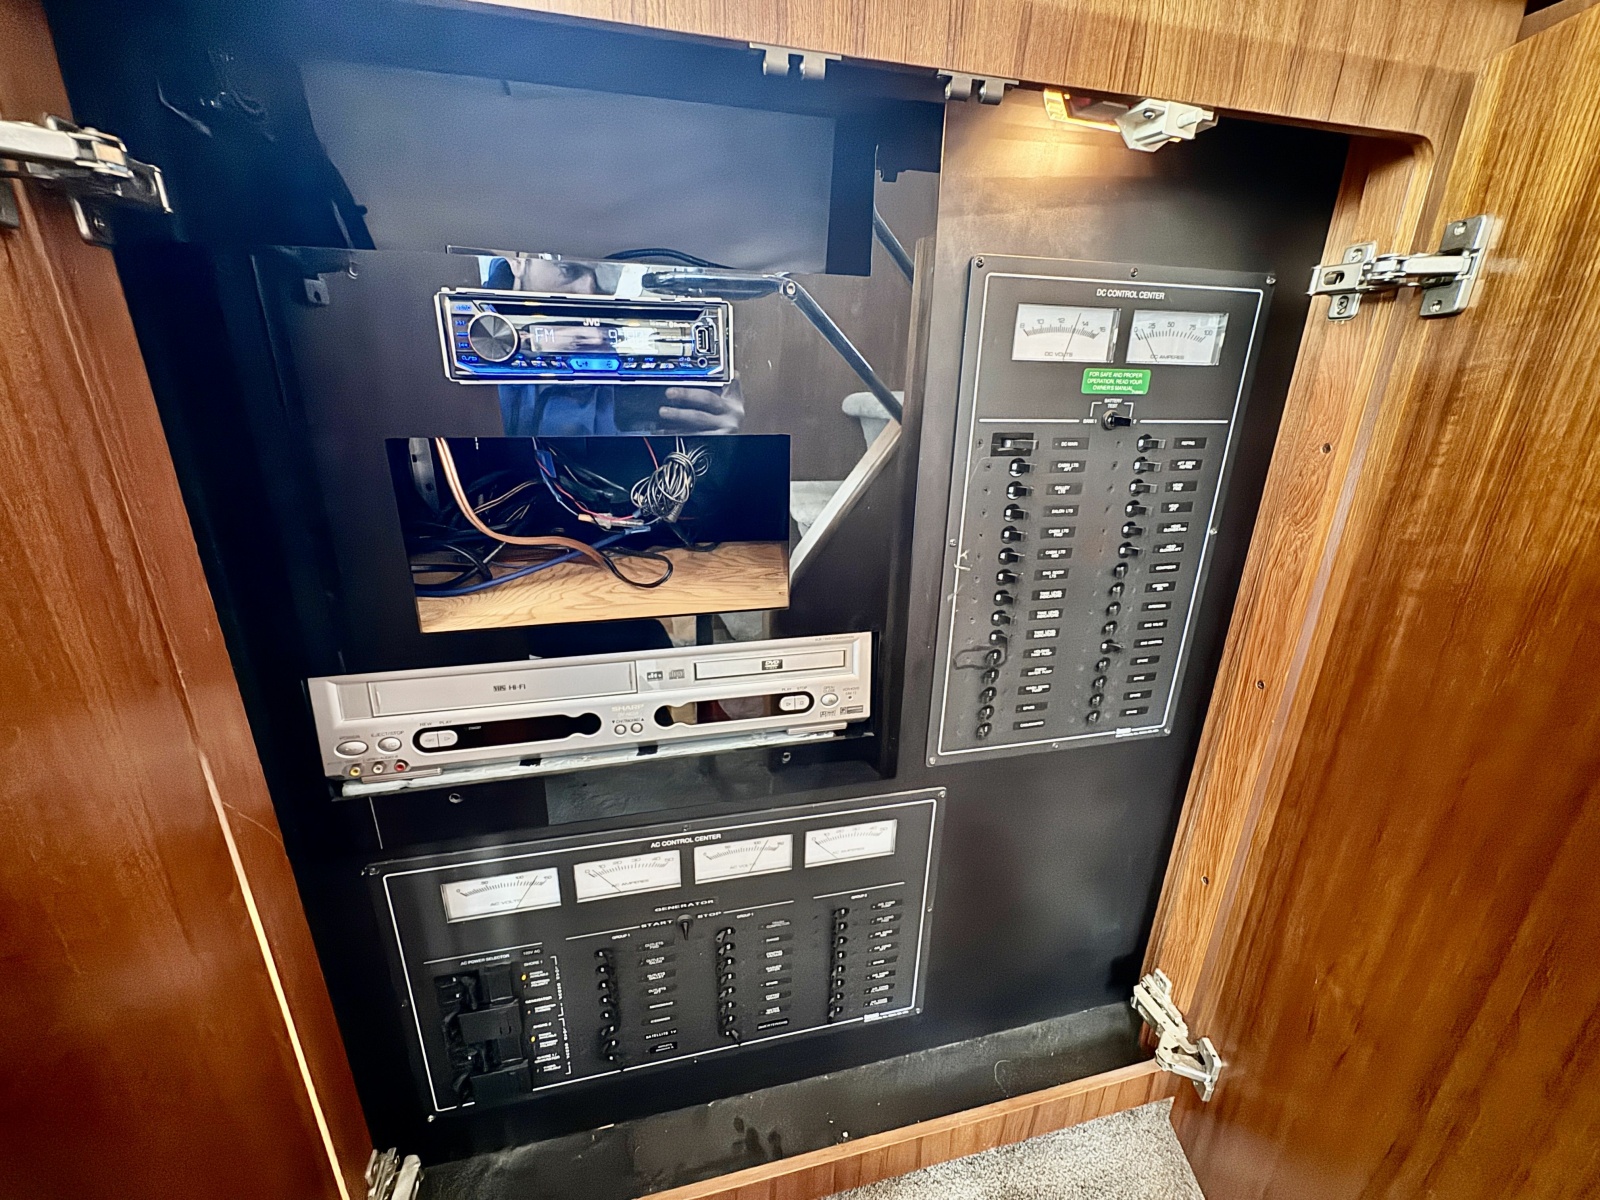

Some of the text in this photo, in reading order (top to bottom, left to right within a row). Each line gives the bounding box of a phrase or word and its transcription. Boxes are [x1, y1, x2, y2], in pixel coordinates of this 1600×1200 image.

[1096, 289, 1165, 300] DC CONTROL CENTER
[583, 318, 600, 327] JVC
[535, 328, 555, 343] FM
[611, 703, 645, 712] SHARP
[650, 833, 722, 849] AC CONTROL CENTER
[654, 899, 714, 912] GENERATOR
[697, 911, 722, 919] STOP
[640, 919, 674, 929] START
[486, 953, 510, 962] SELECTOR
